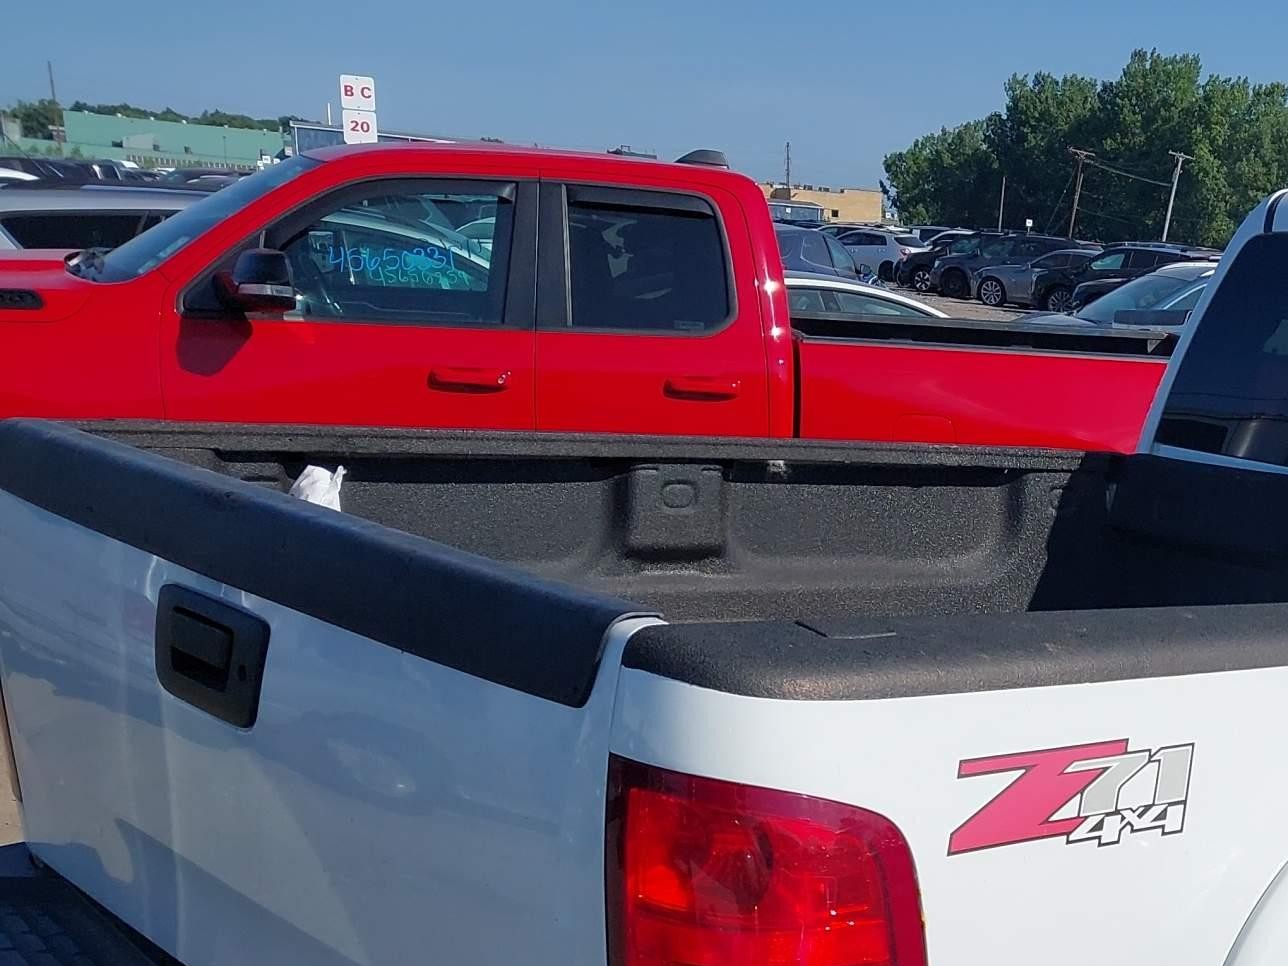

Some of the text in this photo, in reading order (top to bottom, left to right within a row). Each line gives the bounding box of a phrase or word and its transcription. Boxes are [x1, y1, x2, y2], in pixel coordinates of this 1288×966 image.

[343, 84, 373, 100] B C
[350, 120, 371, 133] 20
[946, 738, 1196, 857] Z71
